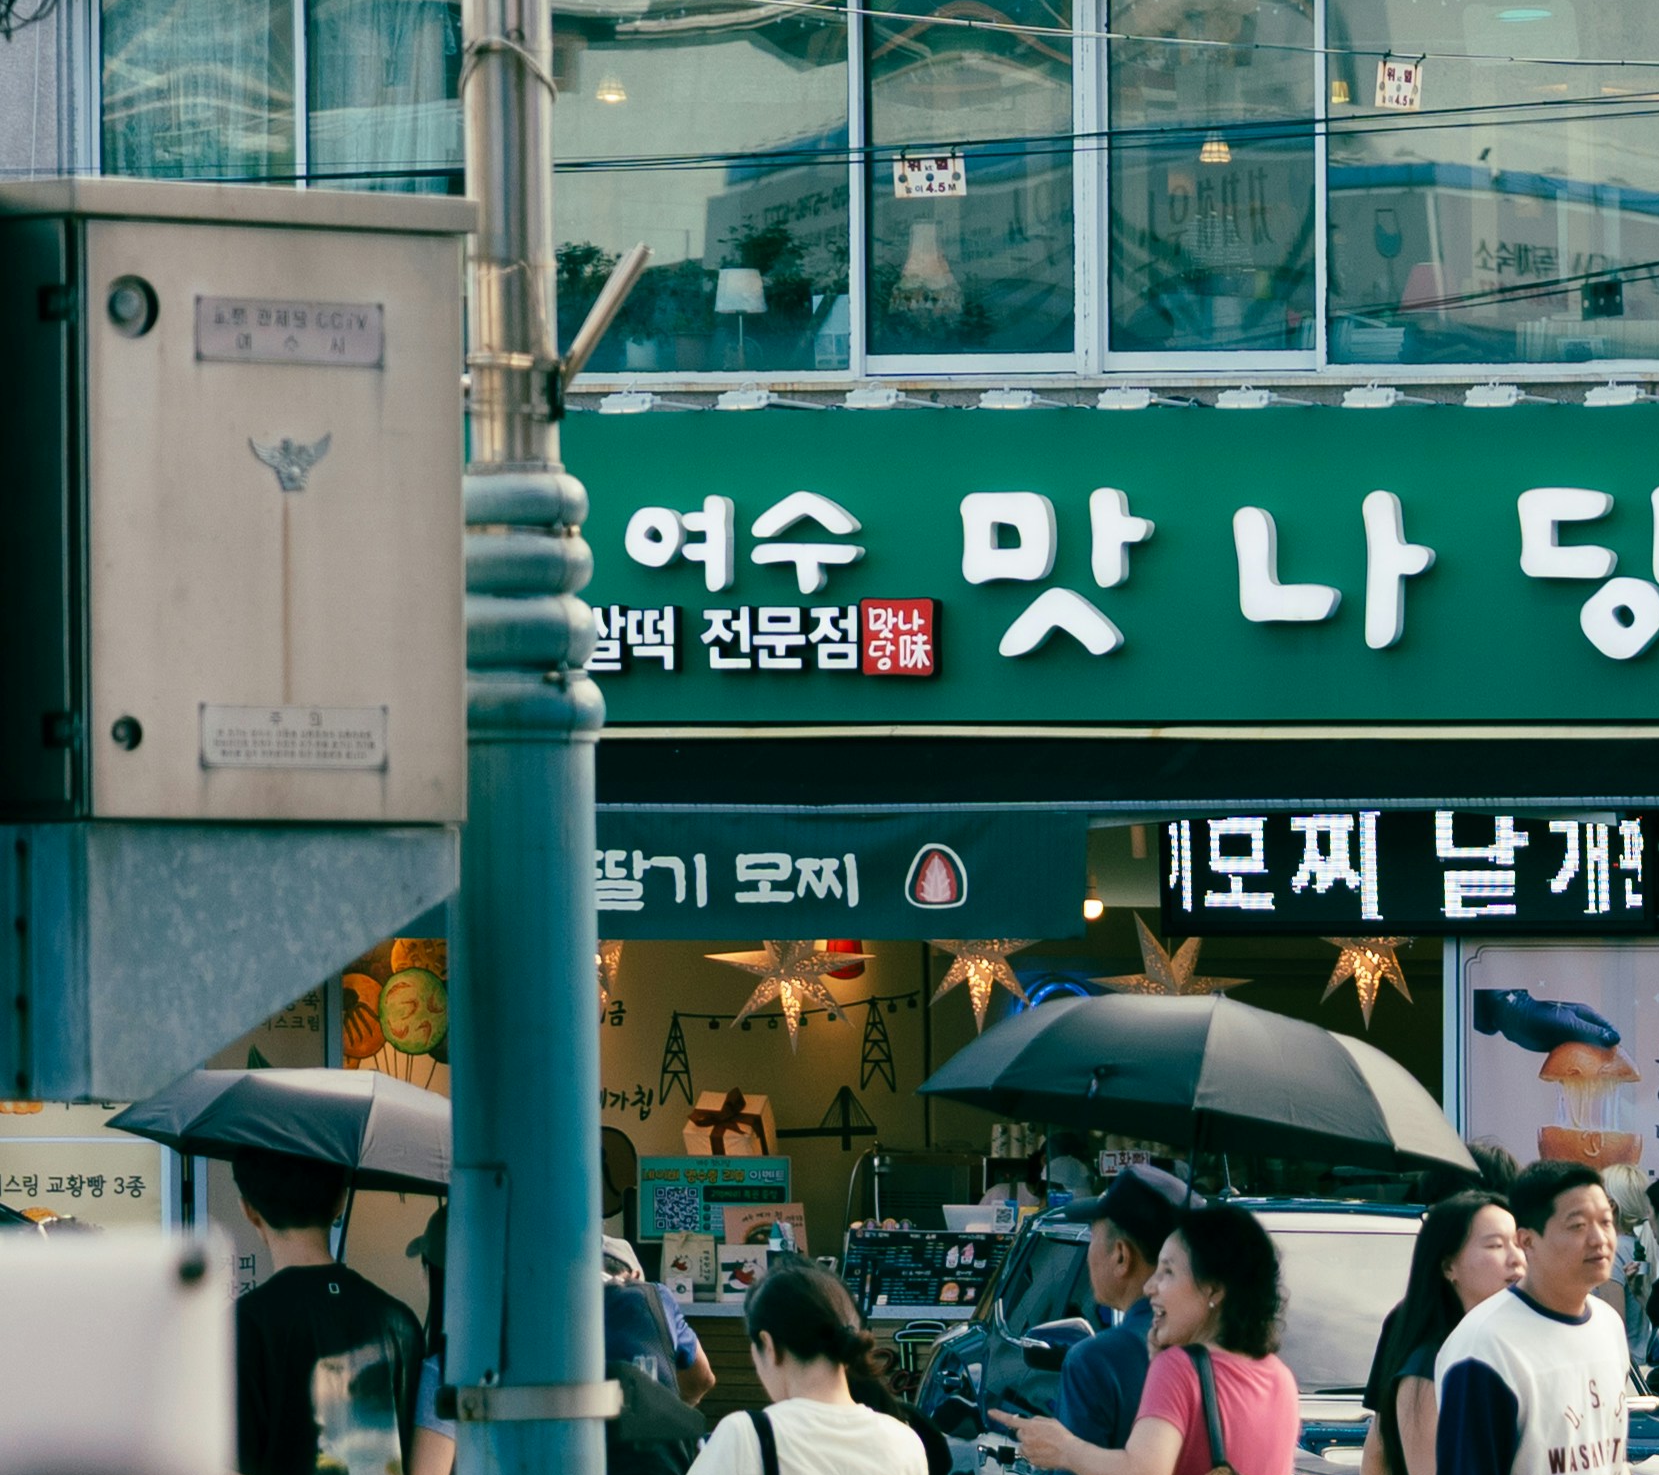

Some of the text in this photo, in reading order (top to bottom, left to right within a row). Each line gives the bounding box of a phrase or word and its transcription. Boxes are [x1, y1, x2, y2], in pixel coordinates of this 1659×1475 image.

[625, 490, 867, 595] 여수
[701, 604, 859, 670] 전문점
[868, 607, 925, 639] 맛나
[735, 851, 860, 909] 모찌
[0, 1174, 146, 1199] 스링 교황빵 3종
[750, 1169, 785, 1182] 이벤트
